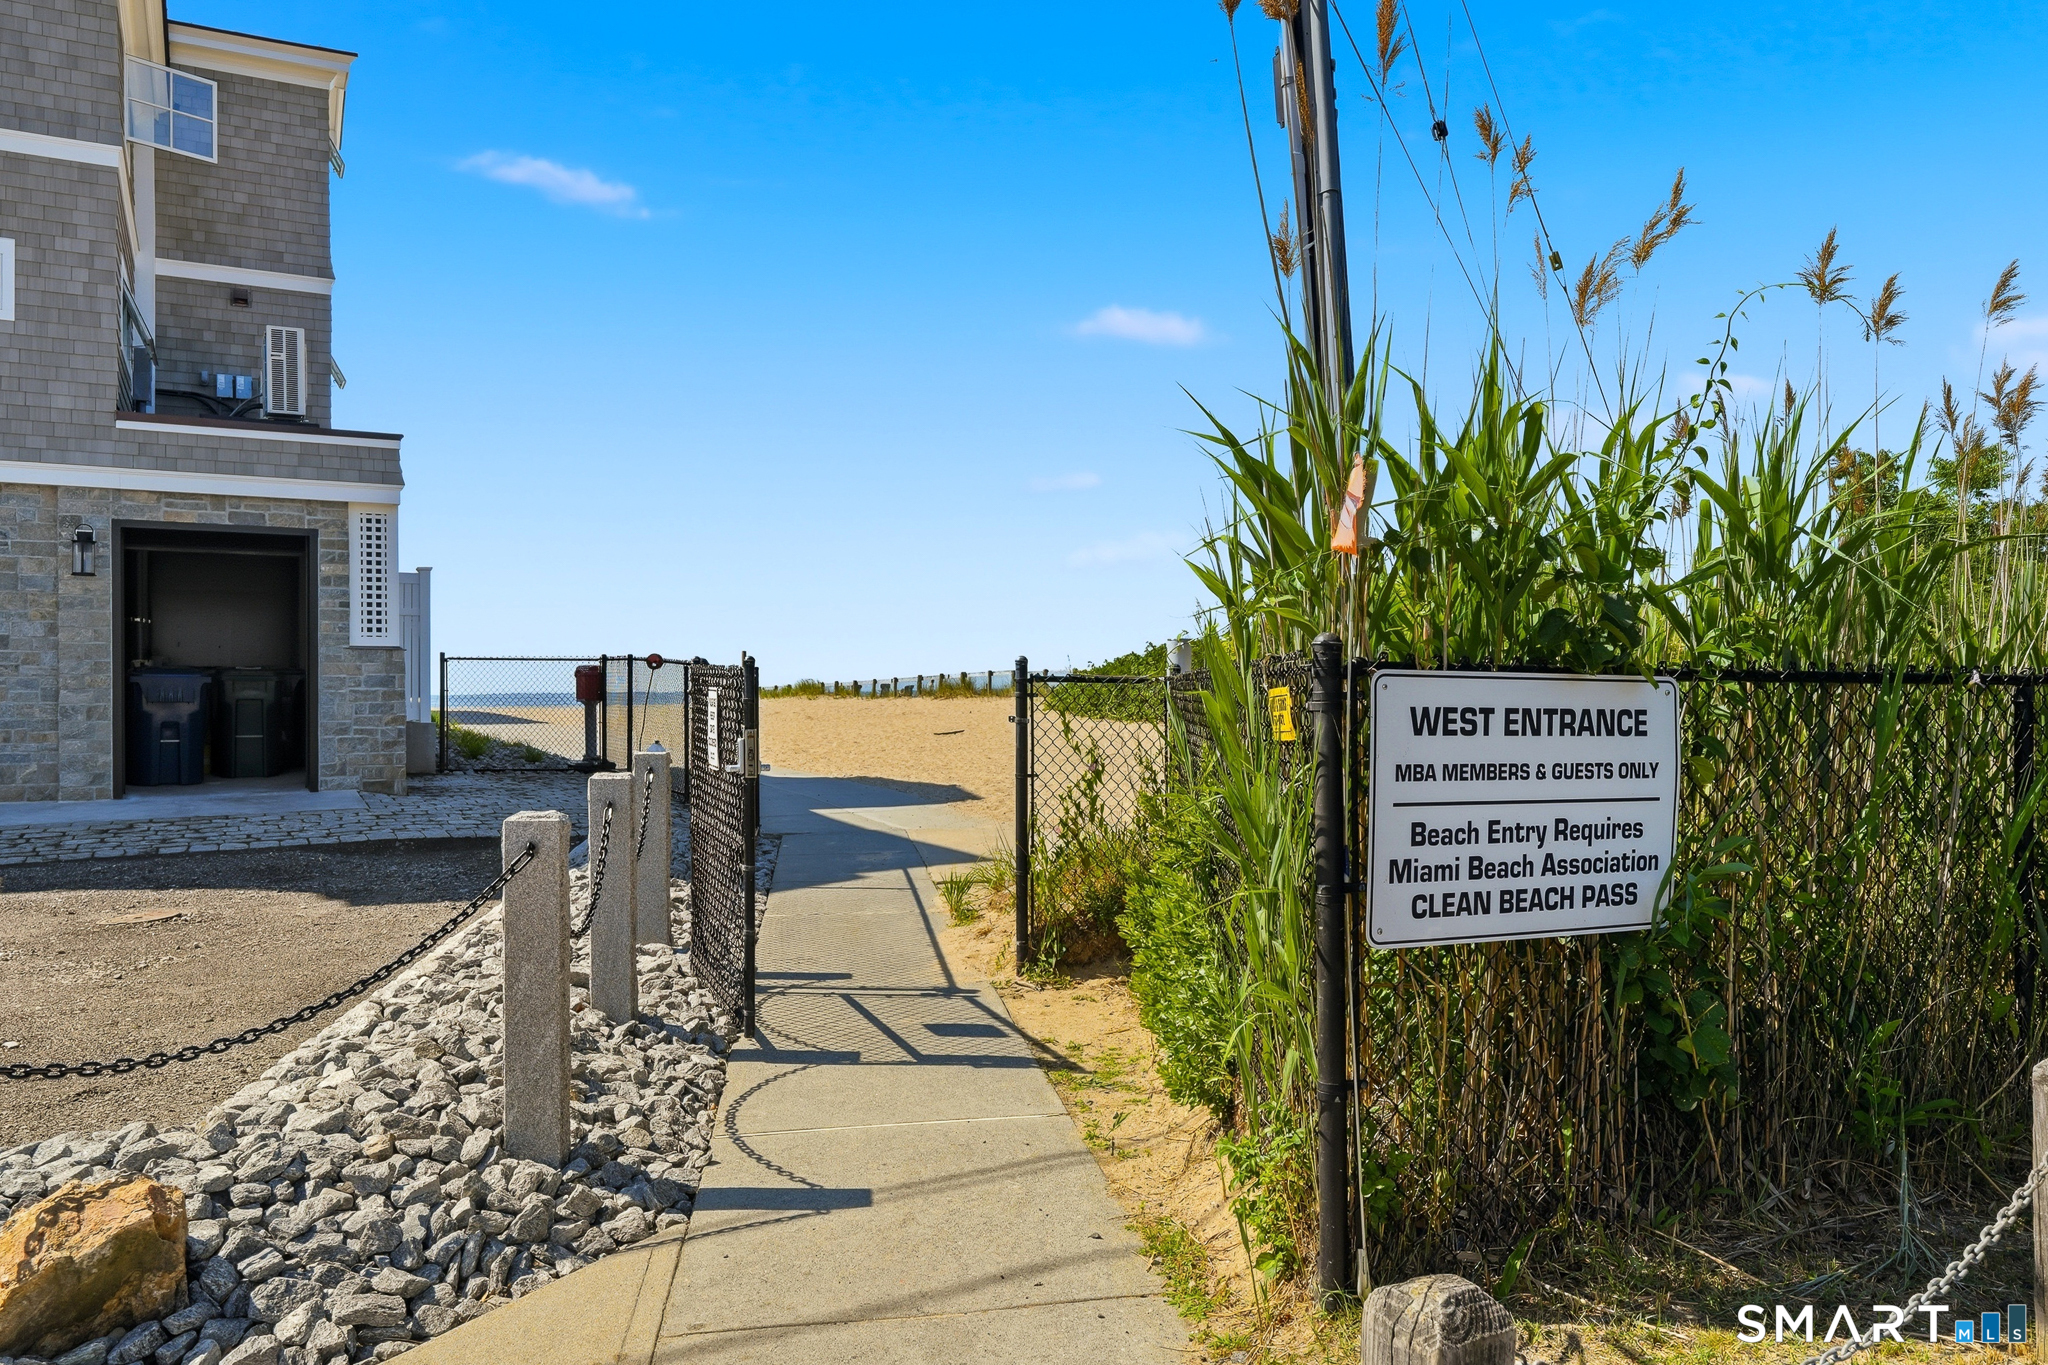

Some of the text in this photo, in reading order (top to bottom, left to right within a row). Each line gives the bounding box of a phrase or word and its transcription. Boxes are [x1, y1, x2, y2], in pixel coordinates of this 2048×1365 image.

[1410, 707, 1647, 736] WEST ENTRANCE
[1396, 762, 1659, 782] MBA MEMBERS & GUESTS ONLY
[1411, 817, 1643, 849] Beach Entry Requires
[1389, 849, 1659, 884] Miami Beach Association
[1412, 882, 1637, 919] CLEAN BEACH PASS
